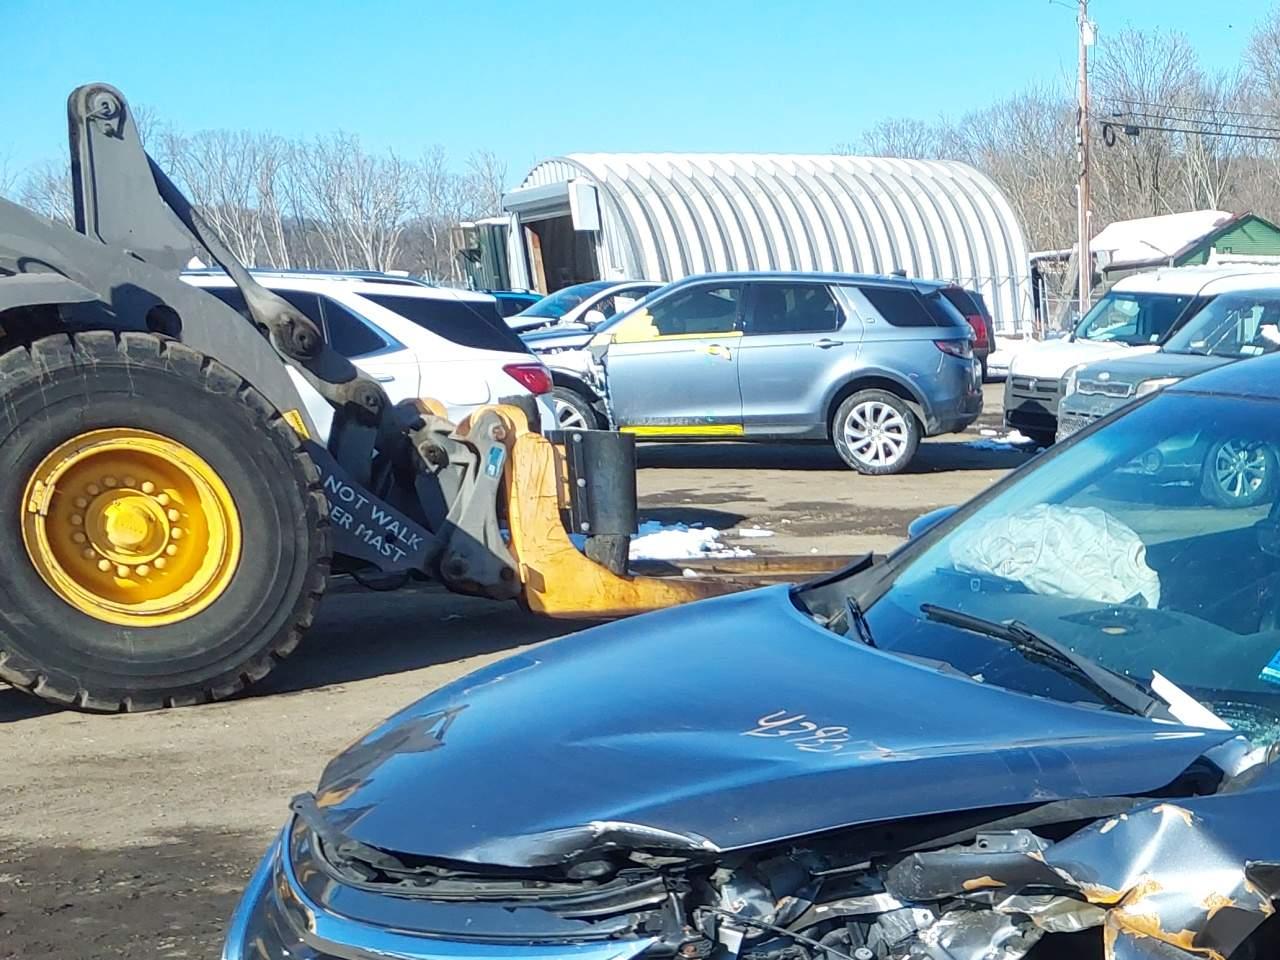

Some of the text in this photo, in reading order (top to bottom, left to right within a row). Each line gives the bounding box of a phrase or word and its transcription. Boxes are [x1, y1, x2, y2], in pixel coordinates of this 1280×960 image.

[323, 475, 424, 552] NOT WALK
[354, 523, 407, 563] MAST
